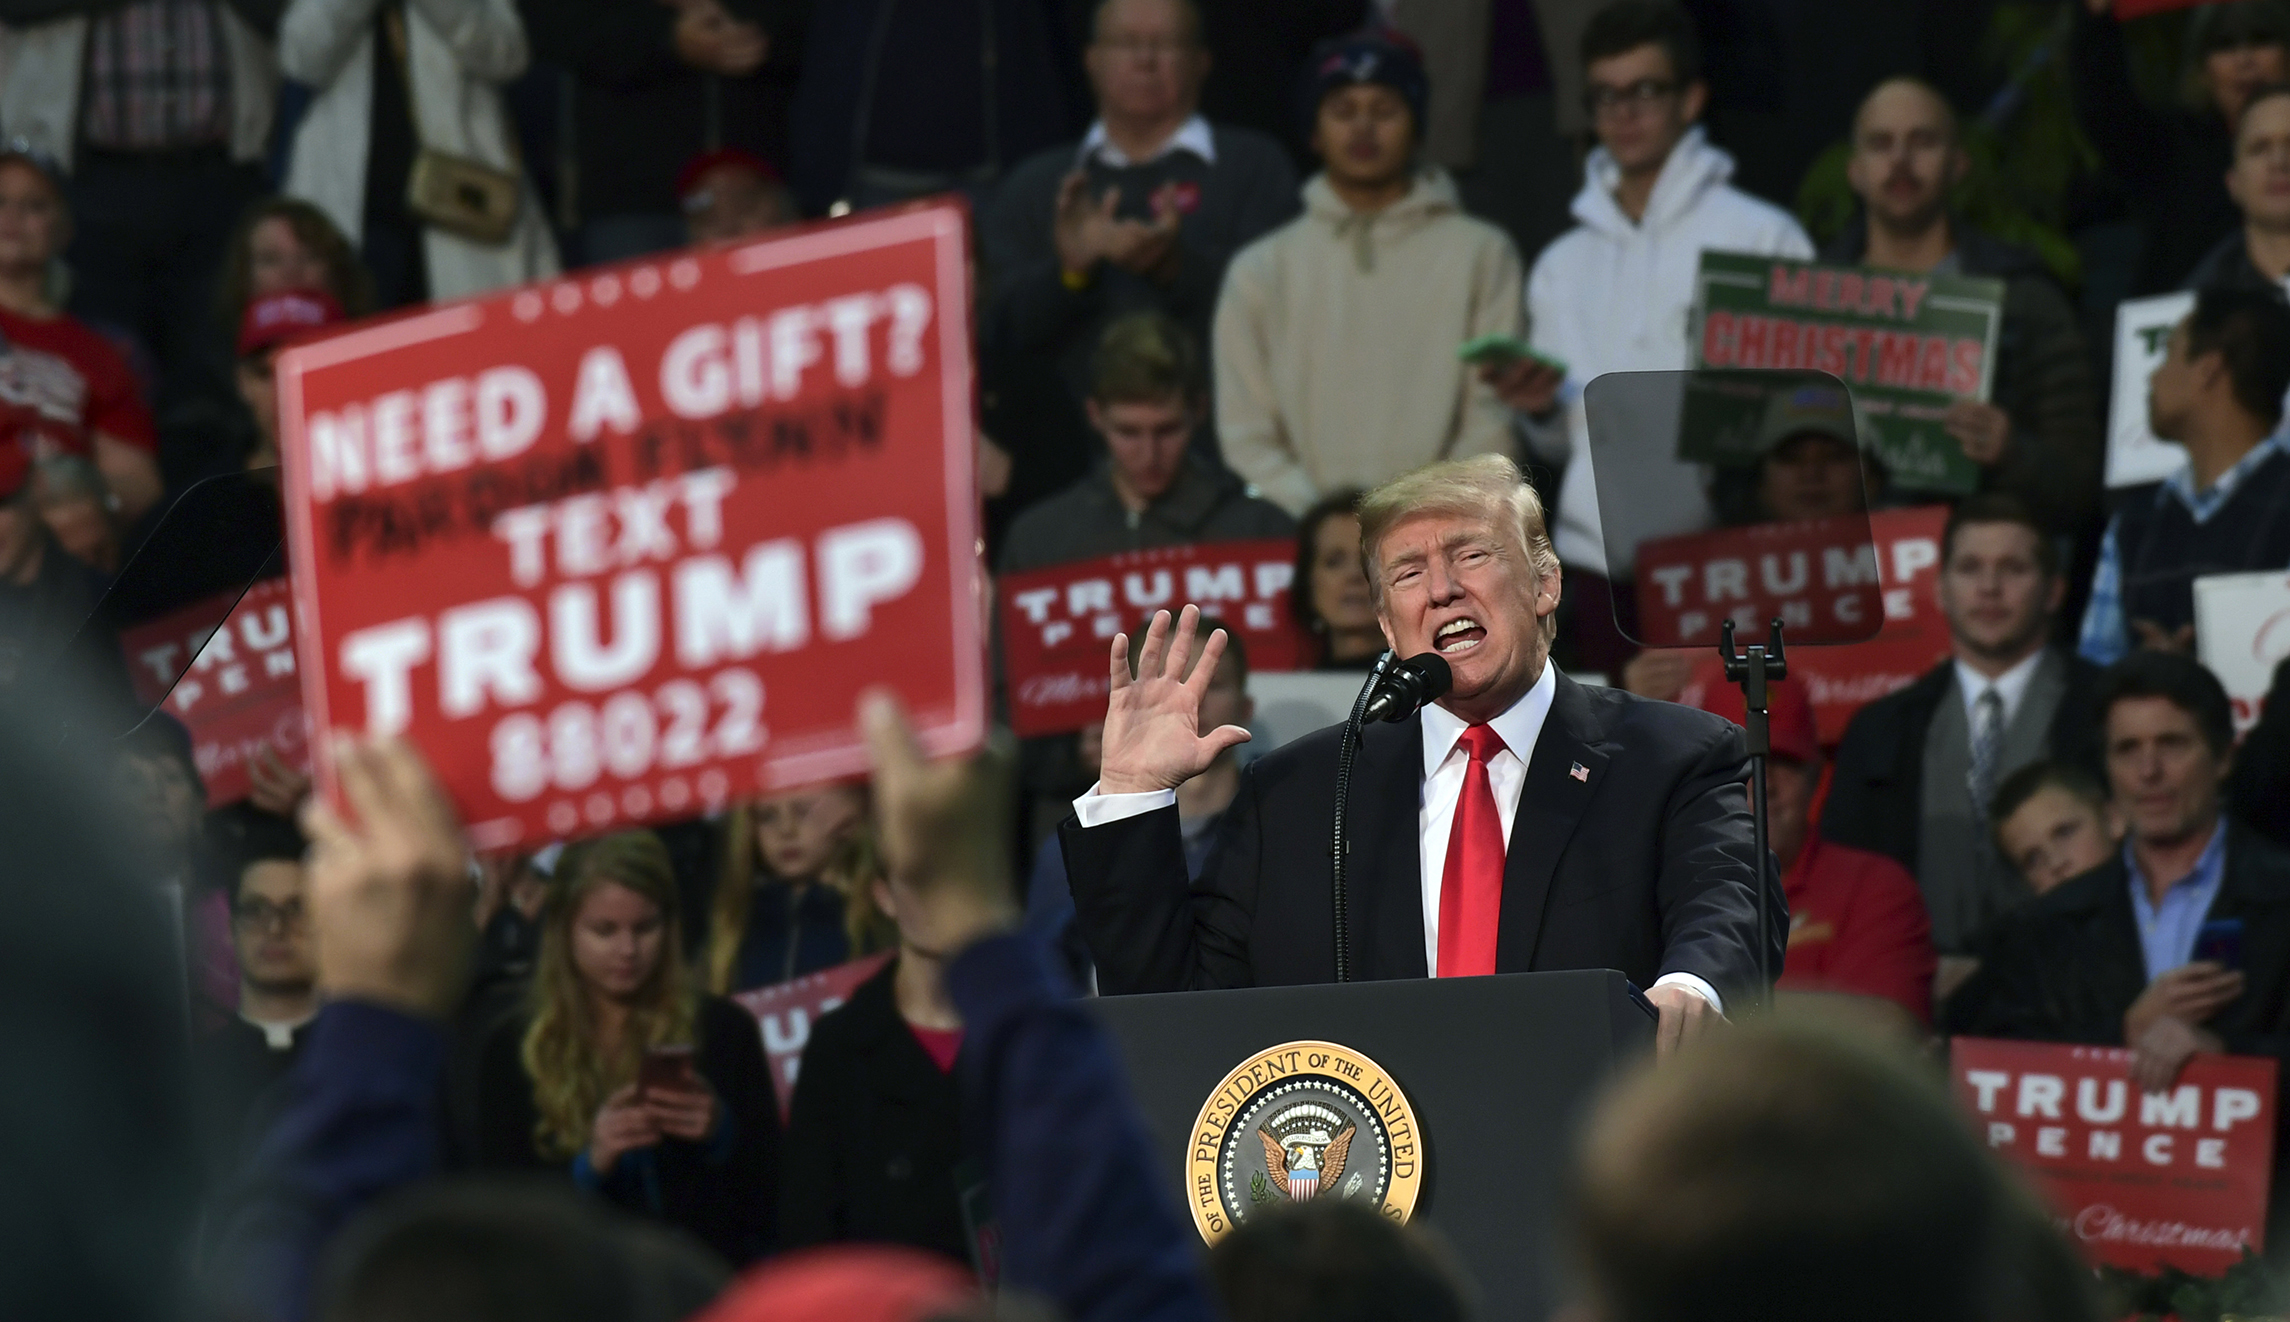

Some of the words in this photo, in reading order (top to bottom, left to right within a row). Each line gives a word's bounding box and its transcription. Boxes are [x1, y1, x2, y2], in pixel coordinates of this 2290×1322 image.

[1769, 265, 1928, 321] MERRY
[1703, 309, 1983, 394] CHRISTMAS
[308, 365, 548, 501] NEED
[569, 345, 641, 444] A
[659, 283, 932, 420] GIFT?
[493, 465, 736, 587] TEXT
[1014, 562, 1296, 623] TRUMP
[1650, 536, 1942, 607] TRUMP
[140, 603, 290, 685] TRU
[340, 517, 924, 736] TRUMP
[1678, 588, 1915, 641] PENCE
[174, 648, 296, 713] PEN
[489, 668, 767, 800] 88022
[1308, 1053, 1330, 1069] OF
[1334, 1057, 1363, 1082] THE
[1195, 1050, 1301, 1164] PRESIDENT
[1368, 1077, 1414, 1179] UNITED
[1966, 1069, 2262, 1131] TRUMP
[1986, 1121, 2230, 1168] PENCE
[1198, 1173, 1214, 1207] THE
[1206, 1211, 1223, 1233] OF
